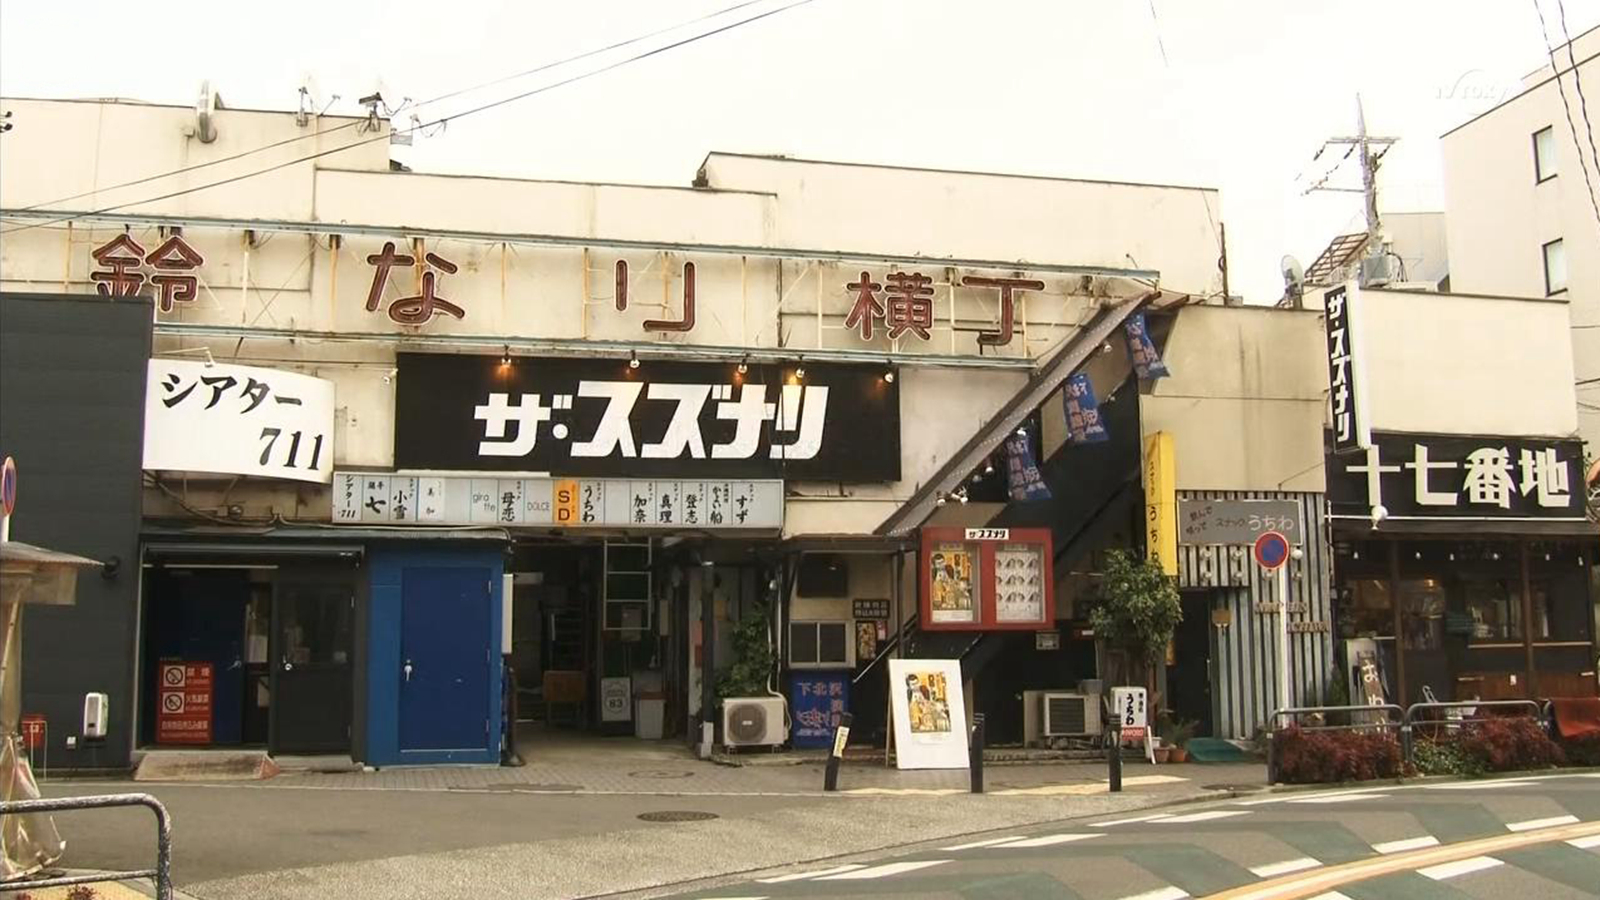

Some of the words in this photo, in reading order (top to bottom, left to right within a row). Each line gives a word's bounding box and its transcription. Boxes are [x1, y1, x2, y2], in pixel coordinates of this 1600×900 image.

[91, 231, 1045, 347] 鈴なり横丁
[1327, 293, 1351, 443] ザ・スズナリ
[161, 373, 302, 414] シアター
[474, 379, 829, 460] ザ・スズナリ
[259, 427, 323, 471] 711
[343, 474, 357, 508] シアター
[1346, 443, 1572, 510] 十七番地
[365, 496, 387, 515] 七
[393, 490, 408, 520] 小雪
[582, 485, 596, 523] うちわ
[633, 494, 648, 524] 加奈
[659, 493, 673, 524] 真理
[735, 495, 749, 524] すず
[1248, 514, 1295, 532] うちわ
[1125, 692, 1135, 726] うちわ
